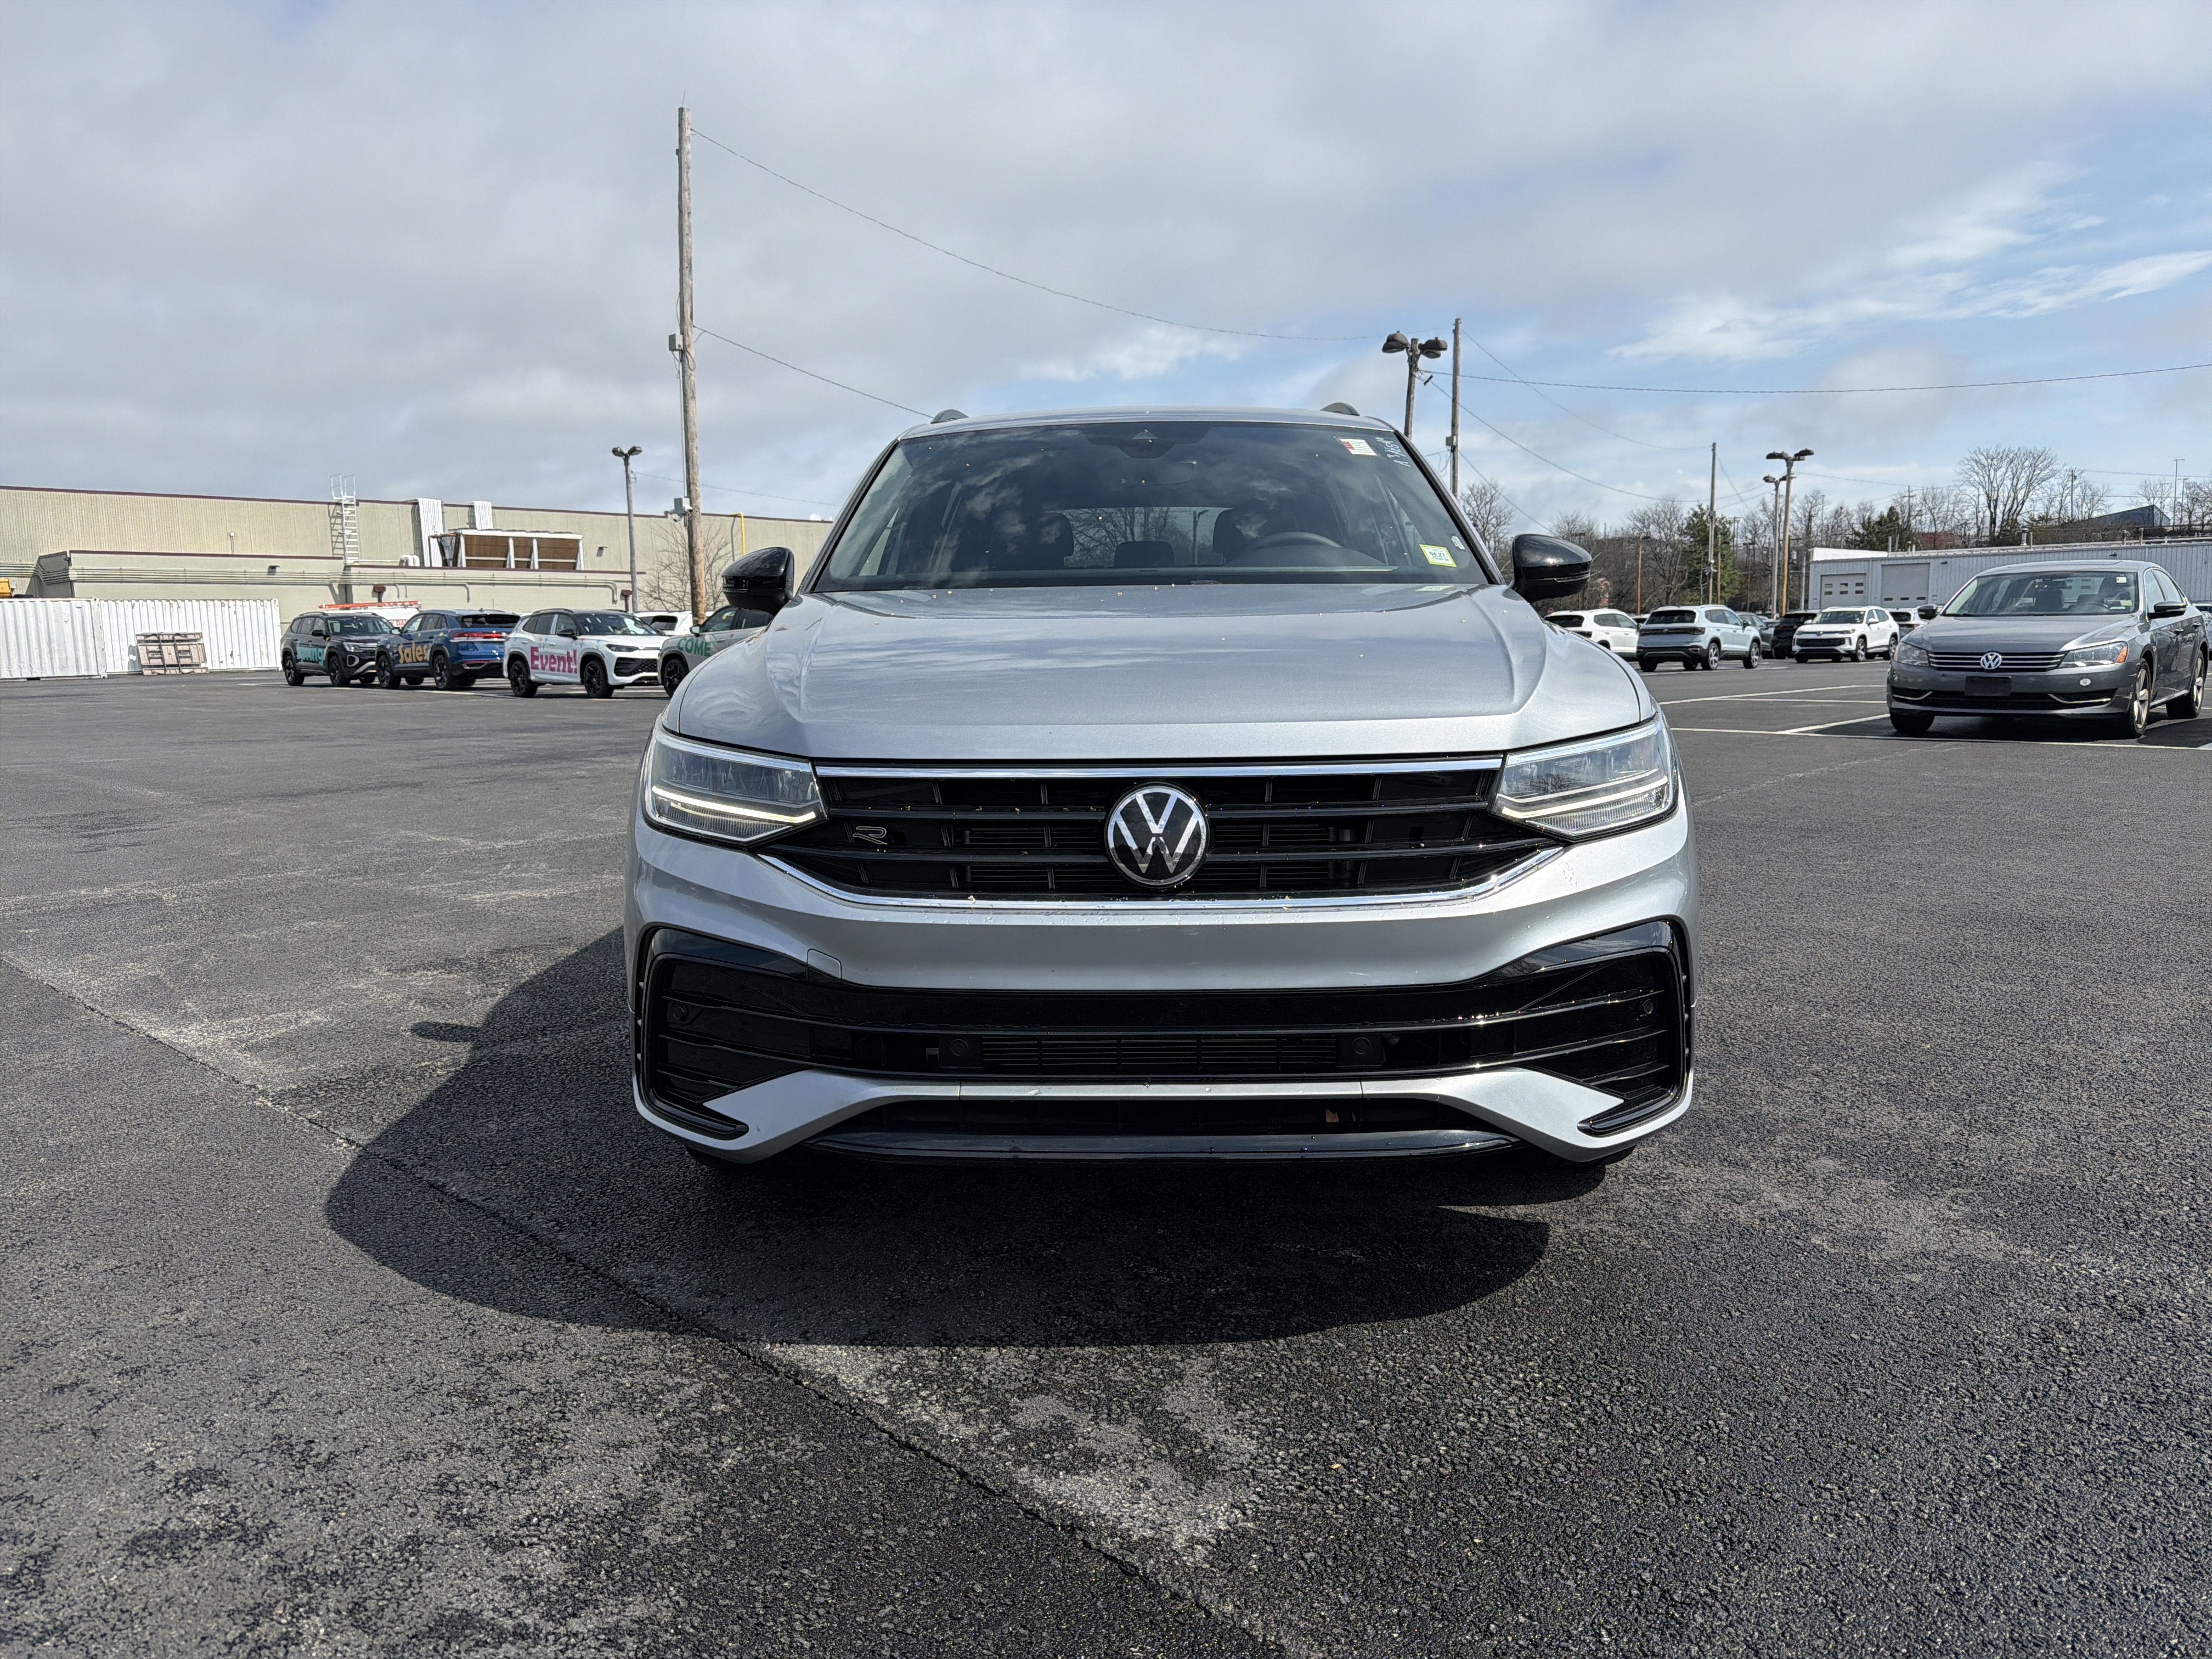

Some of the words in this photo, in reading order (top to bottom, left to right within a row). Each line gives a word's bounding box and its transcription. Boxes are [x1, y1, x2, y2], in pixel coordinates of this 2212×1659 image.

[398, 641, 429, 664] Sales
[677, 637, 711, 657] COME
[531, 647, 577, 674] Event!
[1981, 652, 2001, 669] VW
[853, 826, 888, 845] R
[1111, 789, 1203, 880] VW
